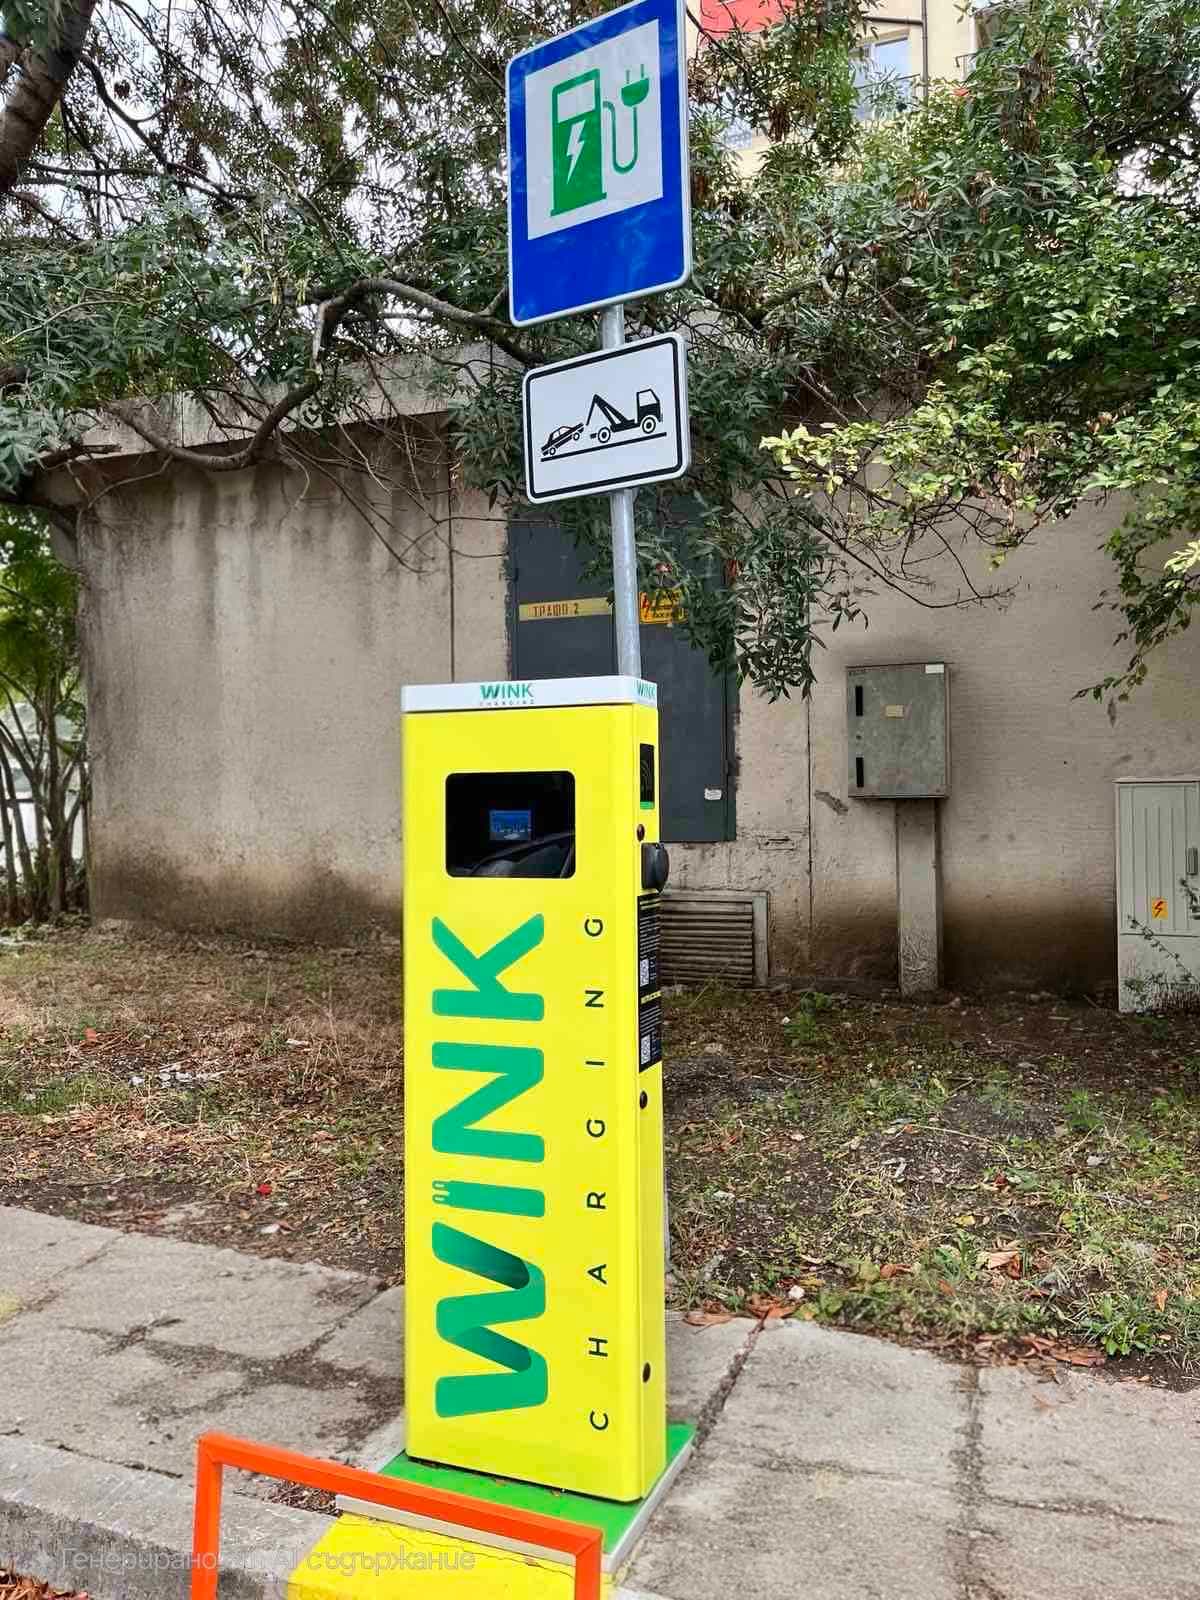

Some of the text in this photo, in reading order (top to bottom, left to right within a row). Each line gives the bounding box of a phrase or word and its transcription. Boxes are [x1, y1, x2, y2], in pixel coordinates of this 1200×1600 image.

[480, 683, 534, 700] WINK
[432, 913, 548, 1418] WINK
[584, 917, 609, 1431] CHARGING
